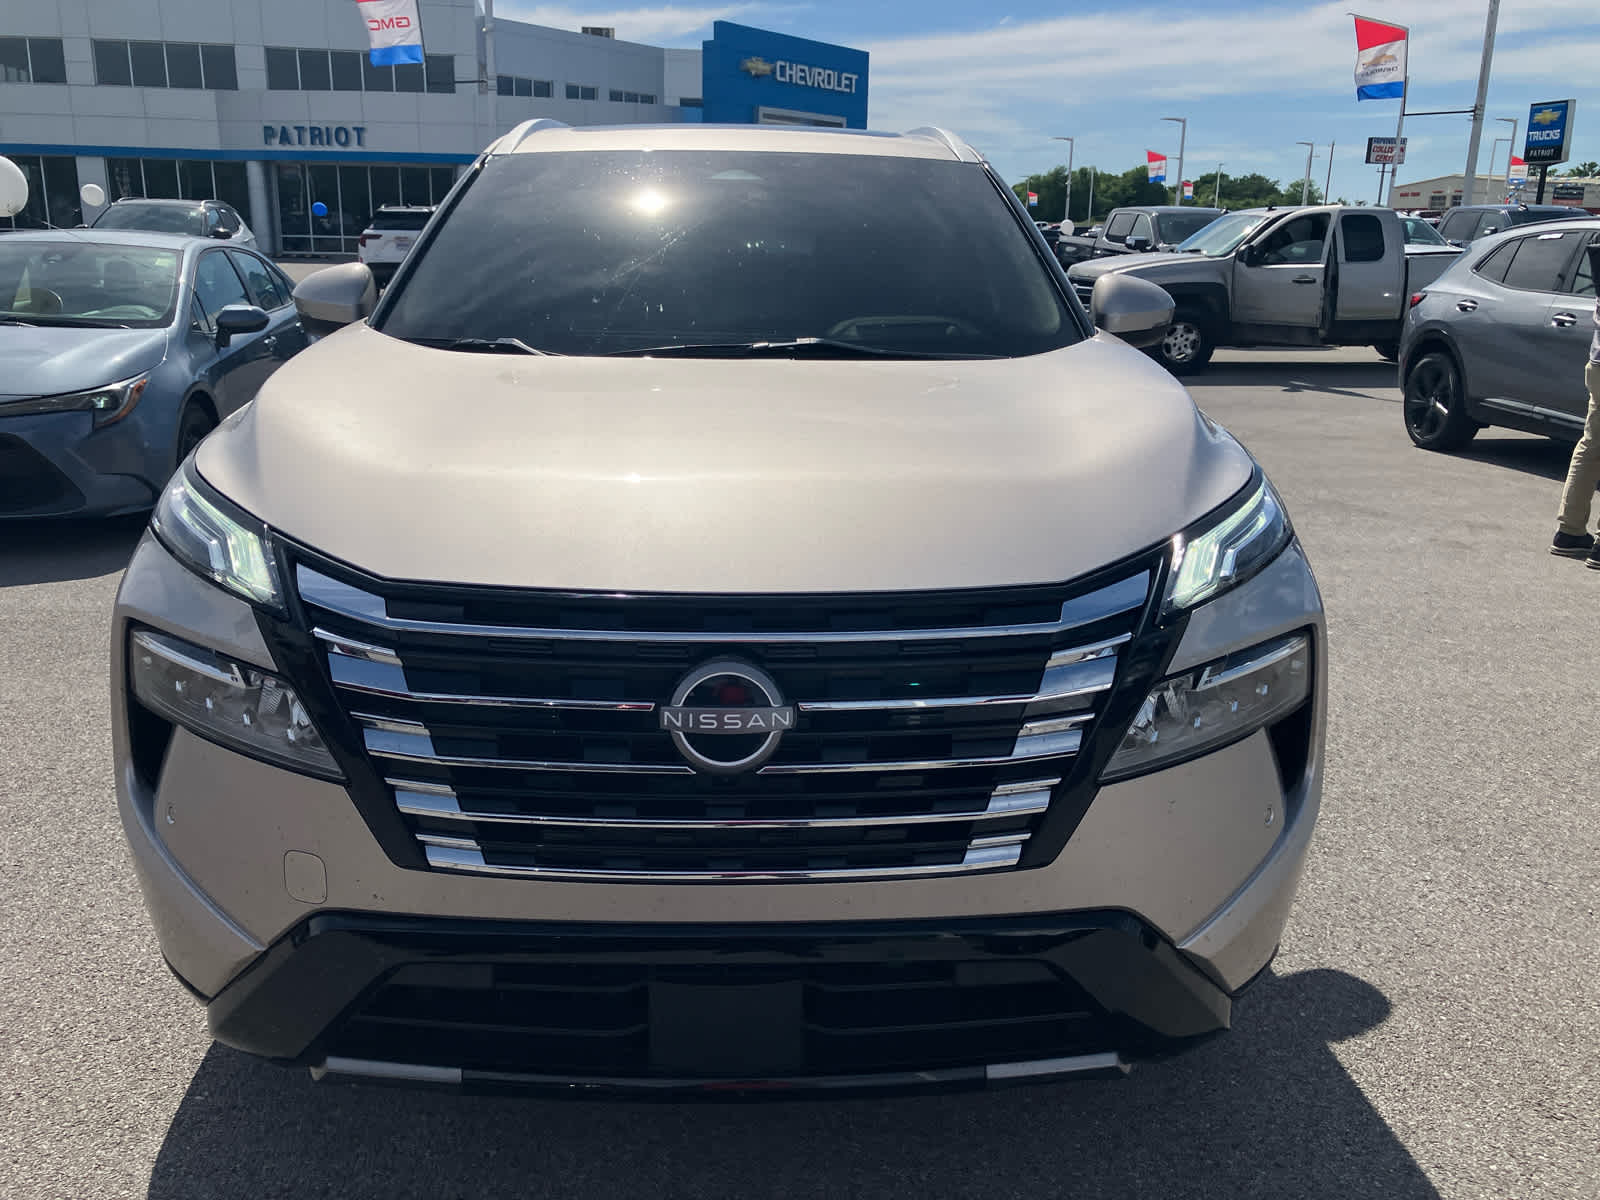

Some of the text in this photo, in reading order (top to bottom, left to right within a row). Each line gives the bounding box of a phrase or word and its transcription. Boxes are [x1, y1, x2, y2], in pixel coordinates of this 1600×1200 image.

[775, 60, 859, 94] CHEVROLET
[263, 125, 366, 146] PATRIOT
[1528, 129, 1561, 141] TRUCKS
[663, 711, 790, 729] NISSAN
